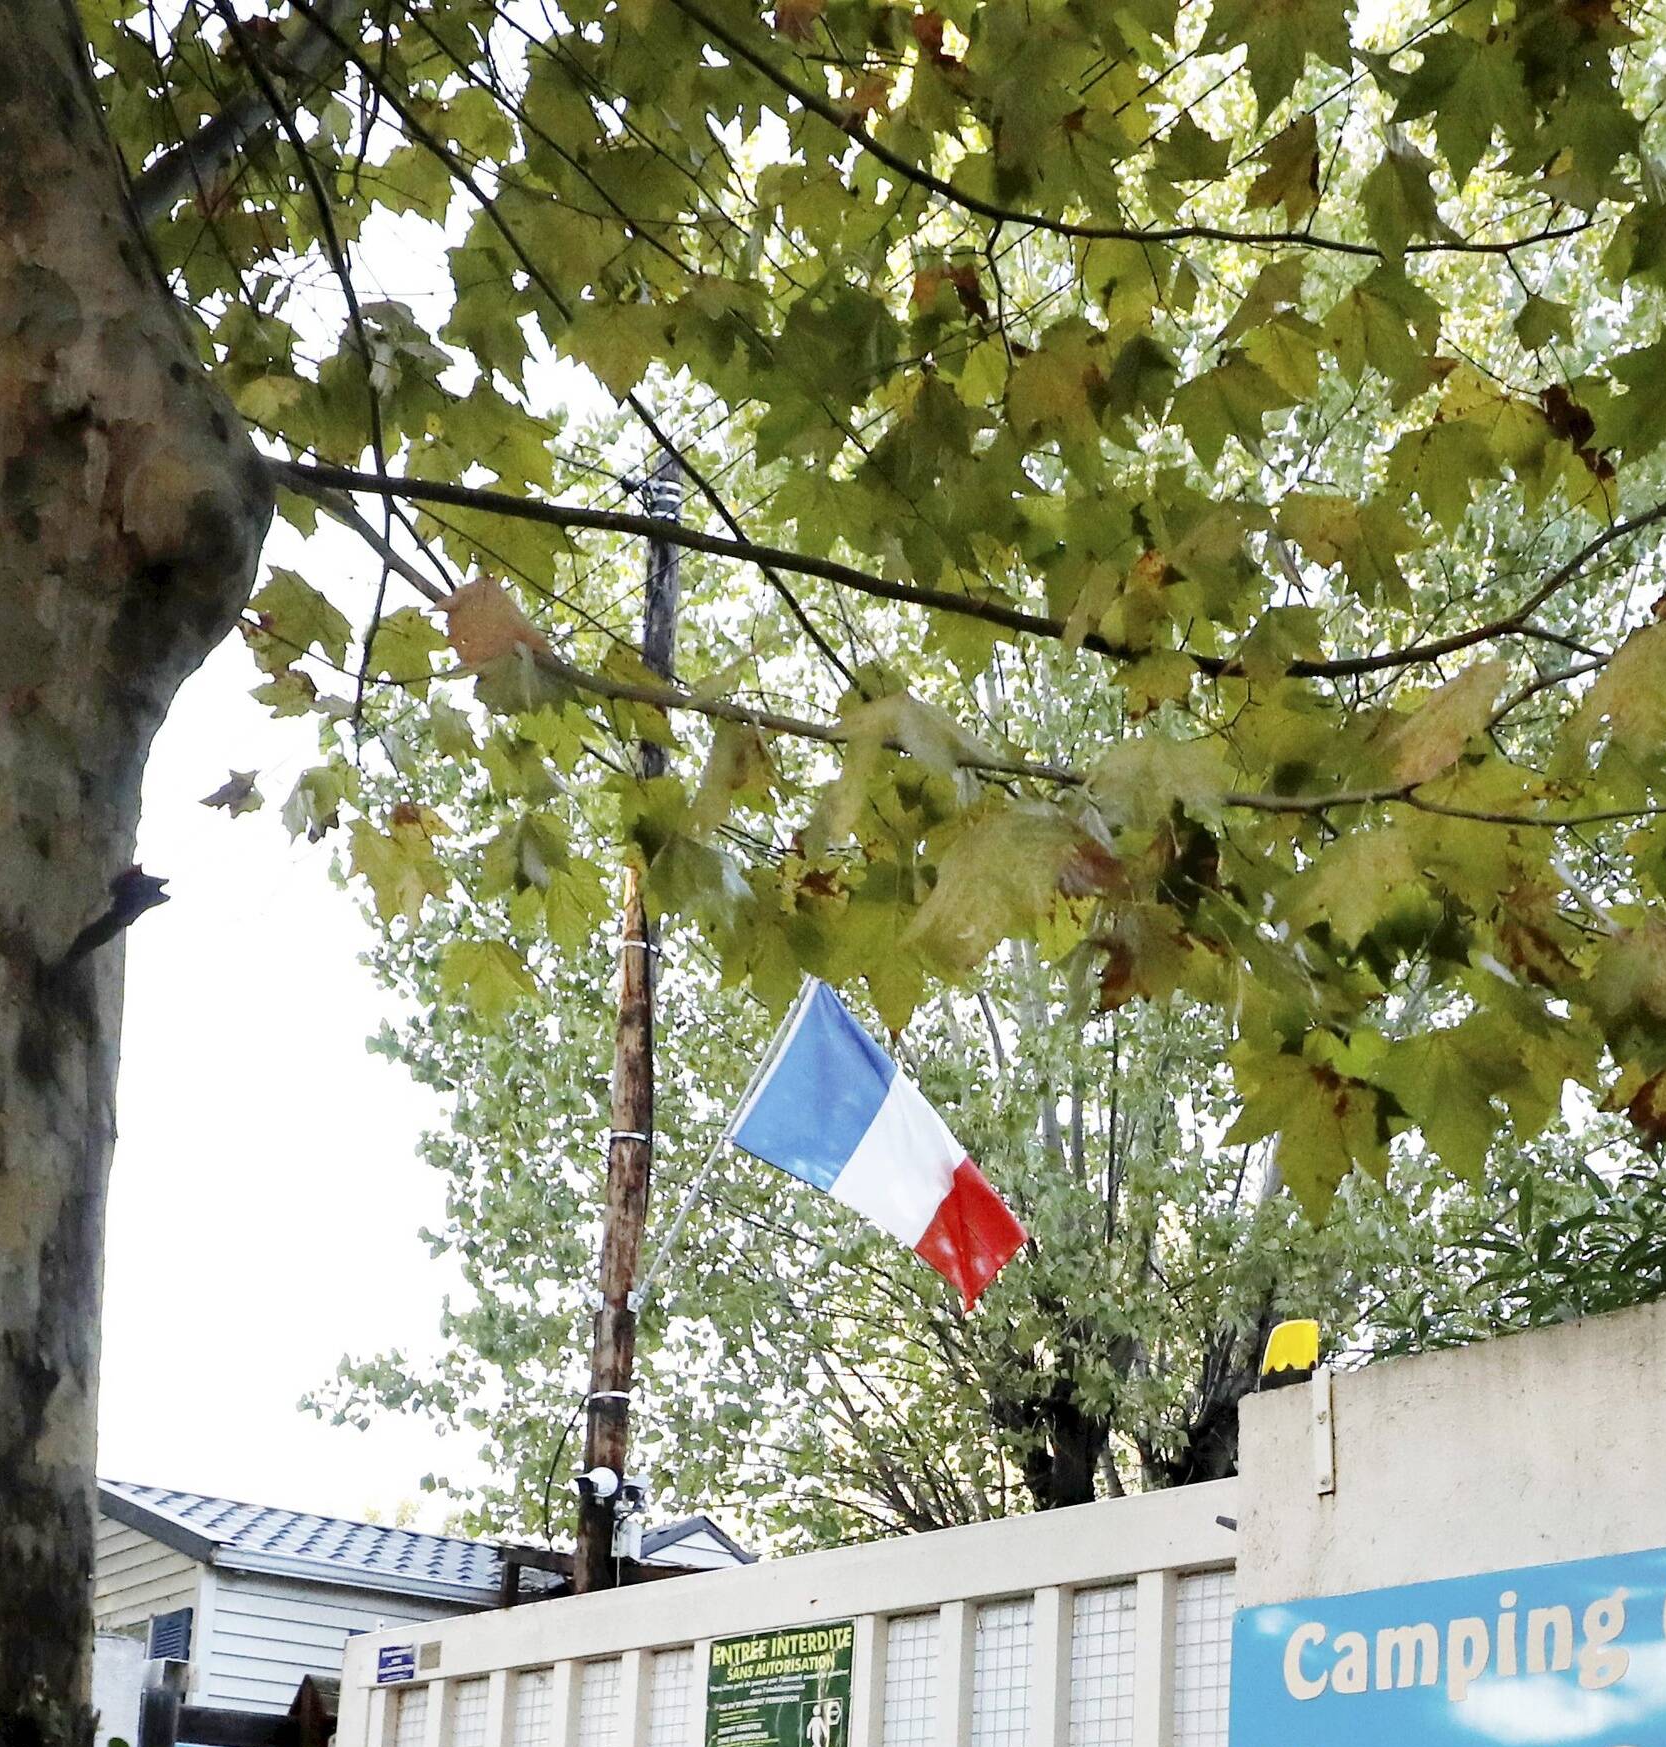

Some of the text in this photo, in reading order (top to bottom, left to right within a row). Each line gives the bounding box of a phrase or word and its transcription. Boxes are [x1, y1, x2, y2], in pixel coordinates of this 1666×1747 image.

[771, 1626, 853, 1658] INTERDITE
[1283, 1586, 1630, 1702] Camping
[727, 1665, 754, 1681] SANS
[755, 1653, 836, 1677] AUTORISATION
